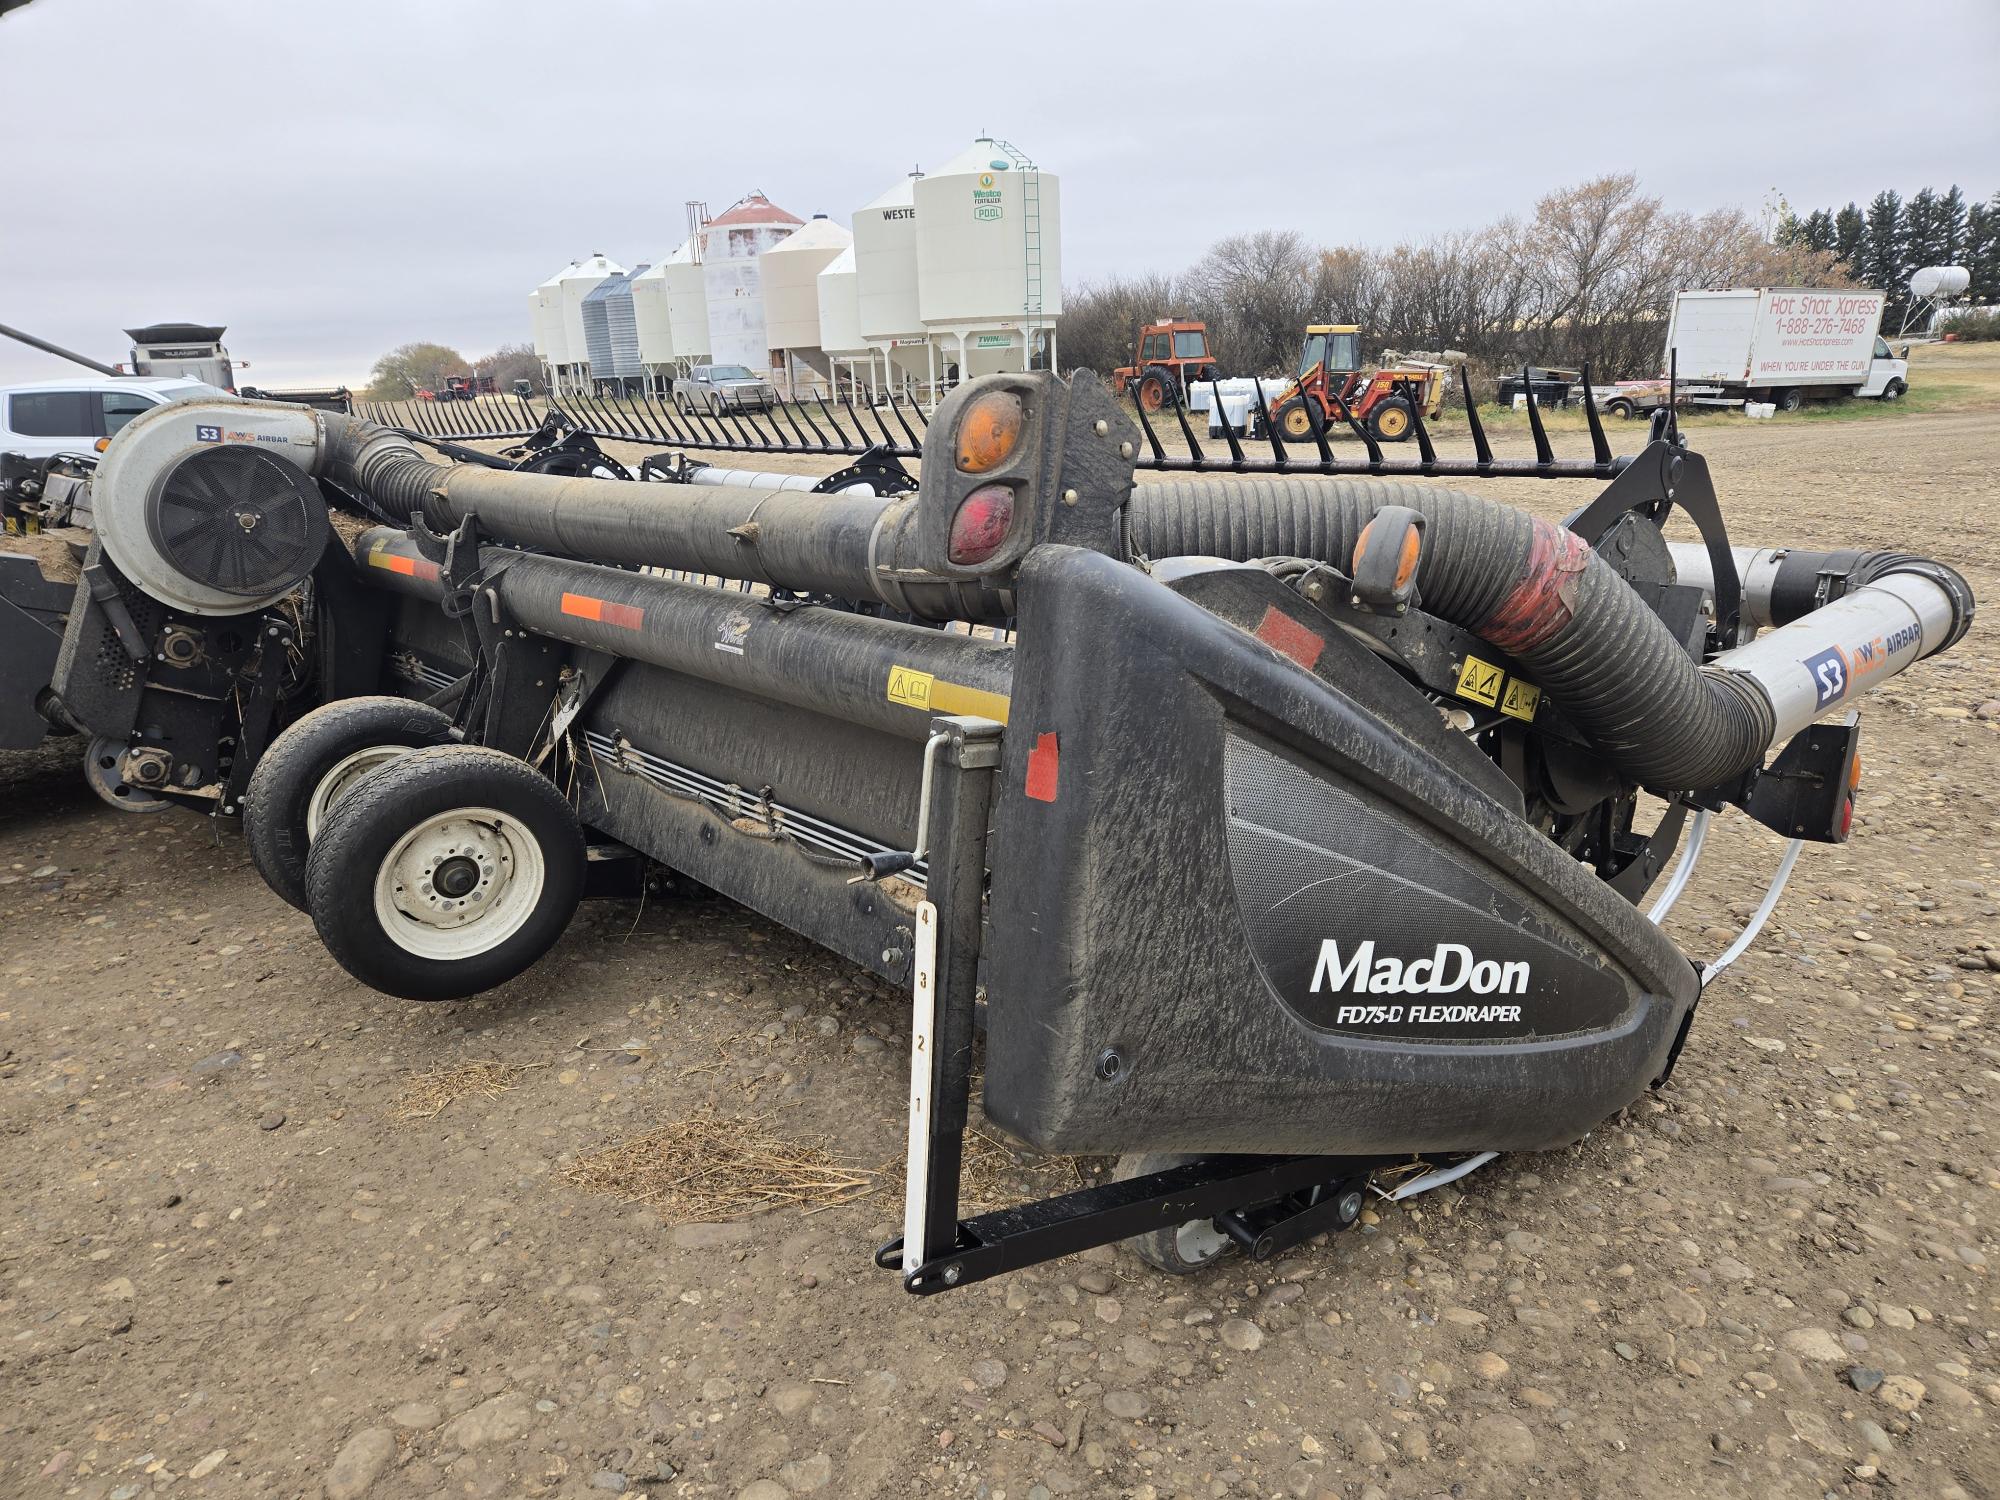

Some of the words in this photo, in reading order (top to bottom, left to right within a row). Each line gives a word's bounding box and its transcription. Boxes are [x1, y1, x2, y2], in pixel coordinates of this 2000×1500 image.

[974, 190, 1001, 198] Westco
[979, 208, 999, 217] POOL
[1769, 296, 1796, 315] Hot
[1800, 296, 1832, 315] Shot
[1835, 296, 1879, 317] Xpress
[1776, 318, 1866, 335] 1-888-276-7468
[1760, 361, 1782, 372] WHEN
[1811, 361, 1835, 371] UNDER
[1837, 360, 1850, 371] THE
[1851, 360, 1866, 371] GUN
[200, 427, 219, 440] S3
[257, 434, 289, 444] AIRBAR
[1817, 658, 1844, 701] S3
[1886, 622, 1921, 656] AIRBAR
[921, 908, 930, 926] 4
[1309, 938, 1531, 995] MacDon
[1336, 1005, 1404, 1025] FD75-D
[1408, 1005, 1522, 1024] FLEXDRAPER
[917, 1035, 925, 1052] 2
[915, 1097, 921, 1113] 1
